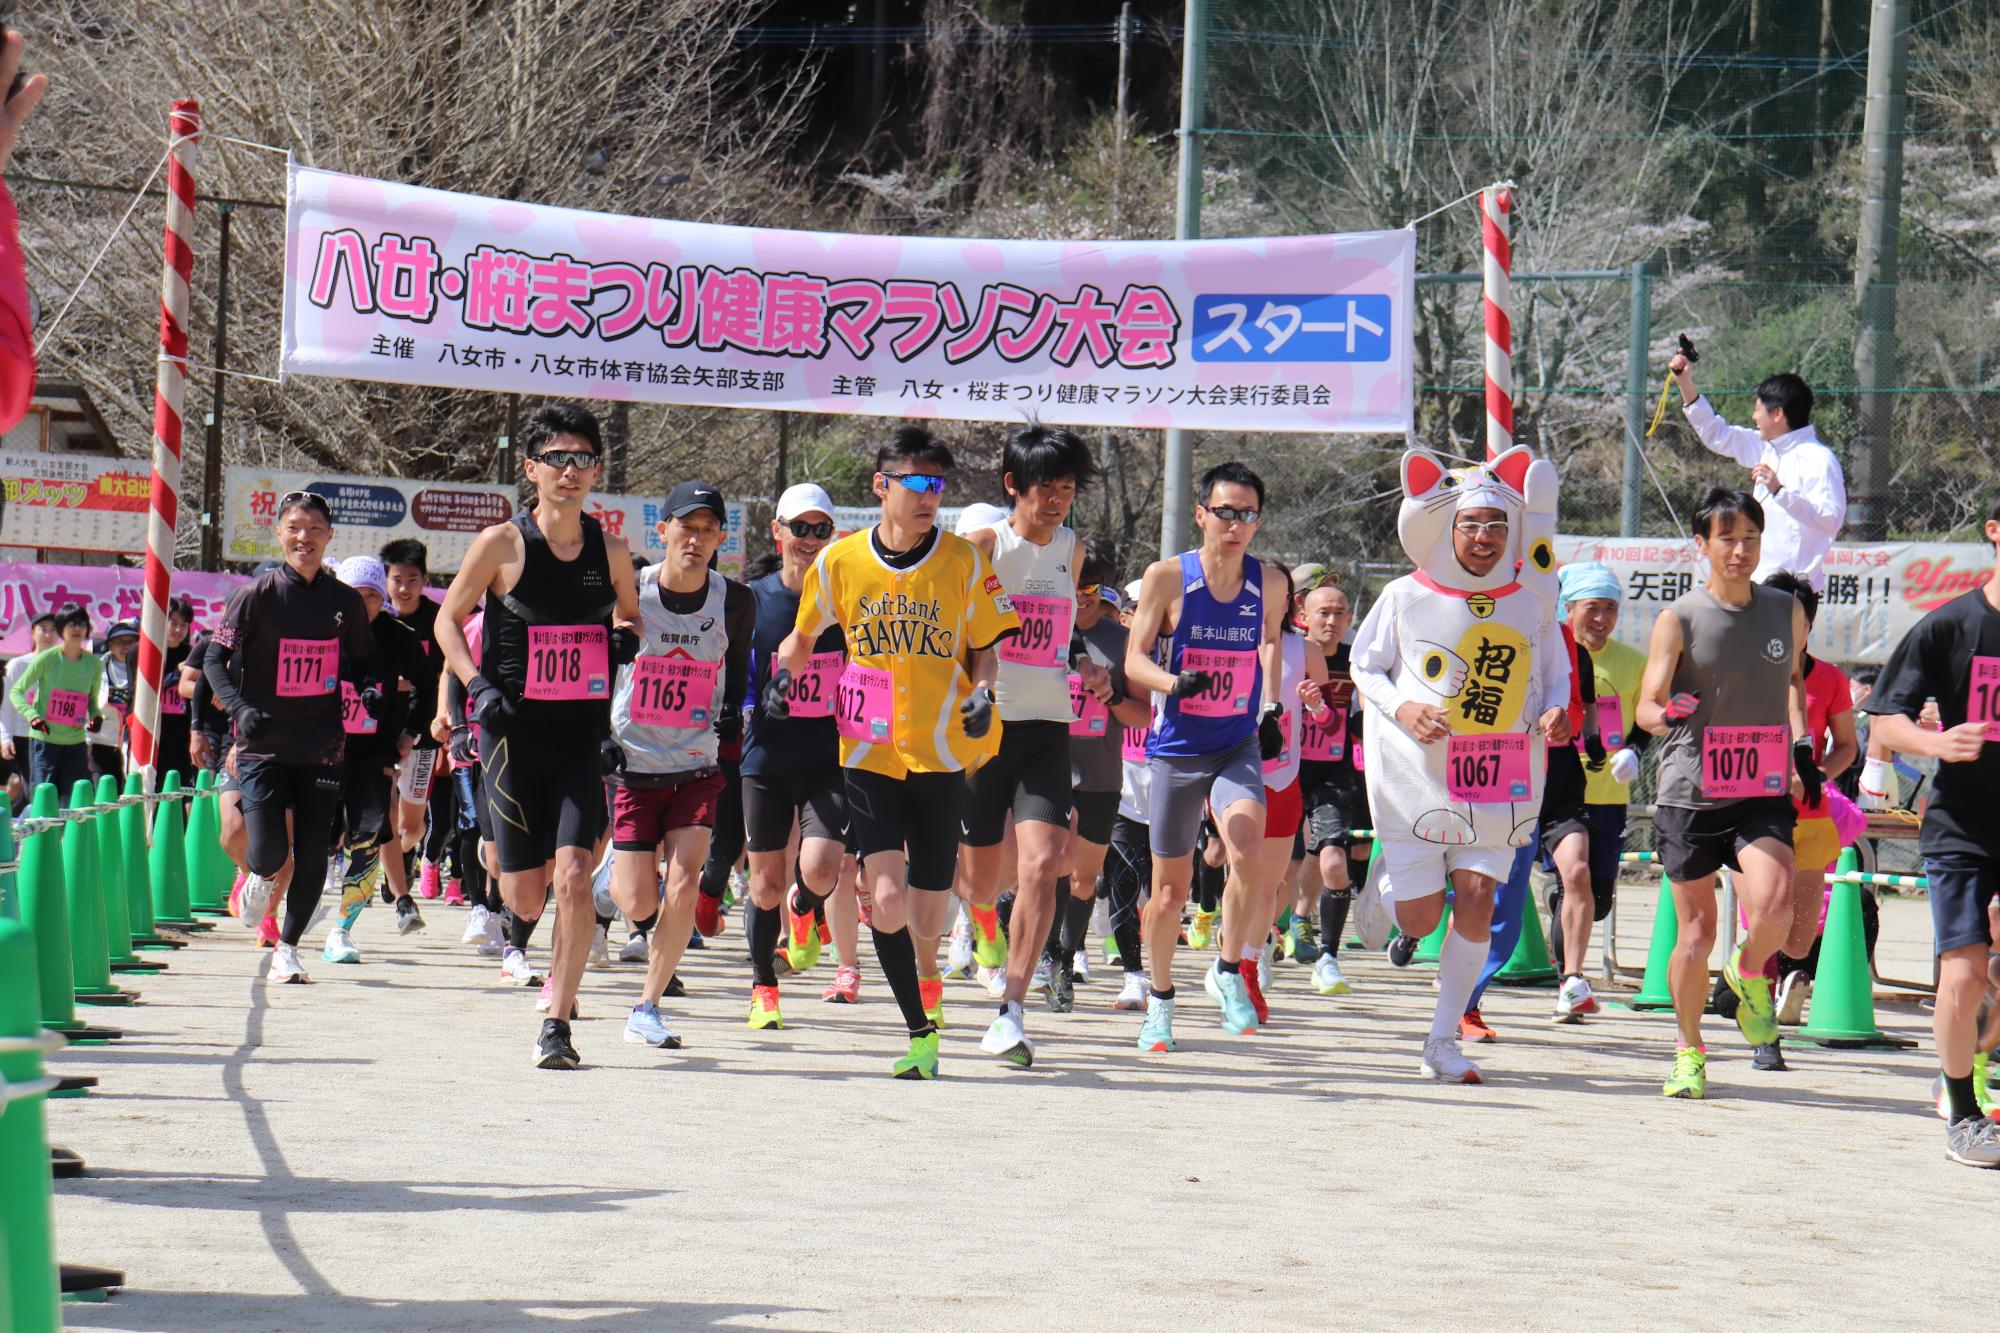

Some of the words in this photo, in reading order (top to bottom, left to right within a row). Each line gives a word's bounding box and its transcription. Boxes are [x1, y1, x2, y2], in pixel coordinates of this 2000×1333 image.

[311, 229, 1181, 371] 八女・桜まつり健康マラソン大会
[1202, 301, 1384, 354] スタート
[370, 333, 415, 360] 主催
[438, 342, 785, 392] 八女市・八女市体育協会矢部支部
[831, 375, 876, 398] 主管
[900, 376, 1331, 406] 八女・桜まつり健康マラソン大会実行委員会
[250, 490, 277, 516] 祝
[859, 592, 941, 622] SoftBank
[660, 632, 701, 646] 佐賀県庁
[849, 619, 953, 658] HAWKS
[1190, 624, 1256, 642] 熊本山鹿RC
[283, 657, 322, 684] 1171
[534, 648, 581, 683] 1018
[1461, 637, 1516, 726] 招福
[51, 699, 76, 718] 1198
[639, 677, 688, 712] 1165
[1451, 754, 1501, 787] 1067
[1708, 747, 1759, 781] 1070
